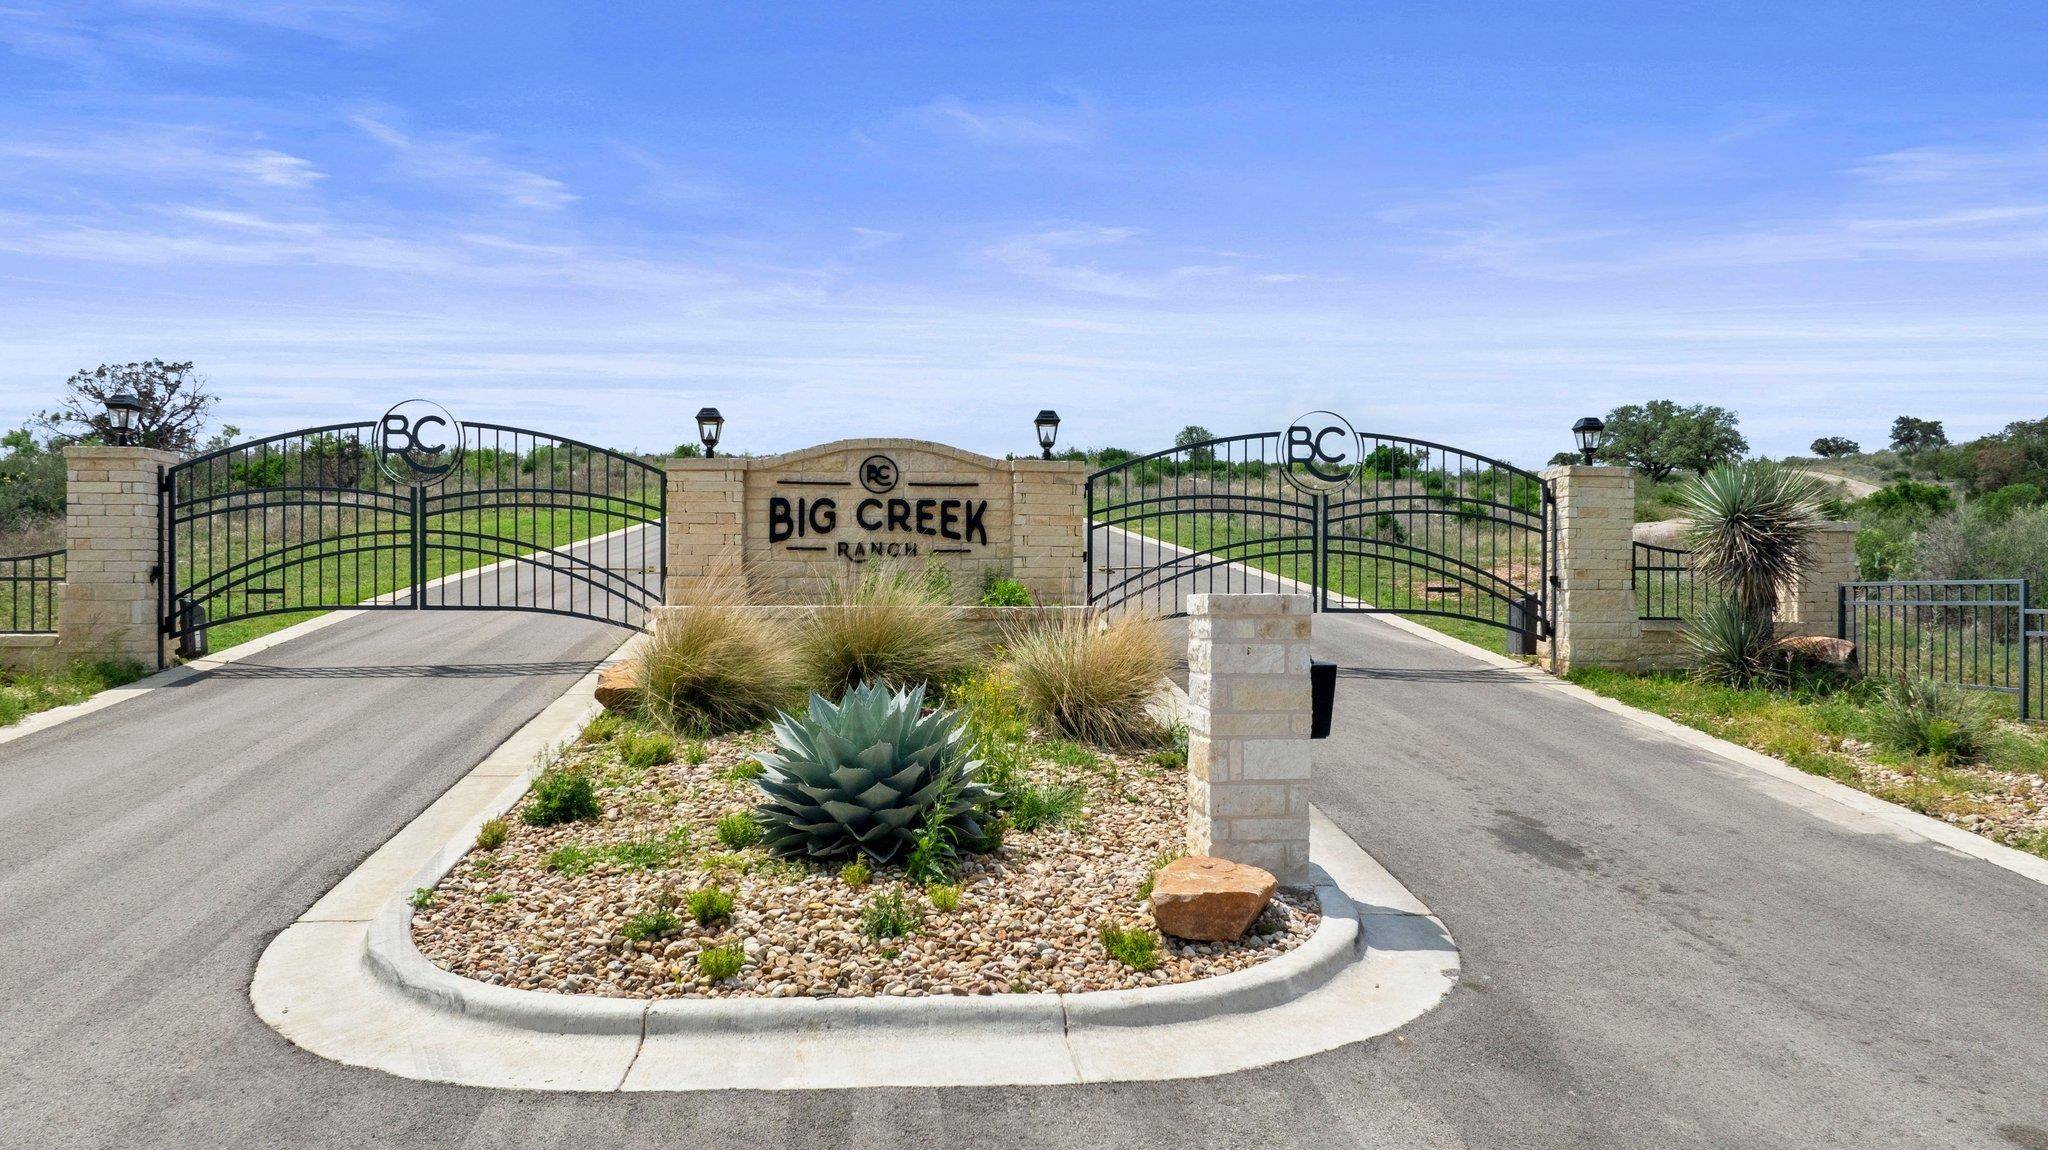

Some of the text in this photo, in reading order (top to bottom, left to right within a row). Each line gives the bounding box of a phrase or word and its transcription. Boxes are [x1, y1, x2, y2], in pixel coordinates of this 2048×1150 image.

[769, 496, 987, 546] BIG CREEK
[837, 541, 918, 563] RANCH
